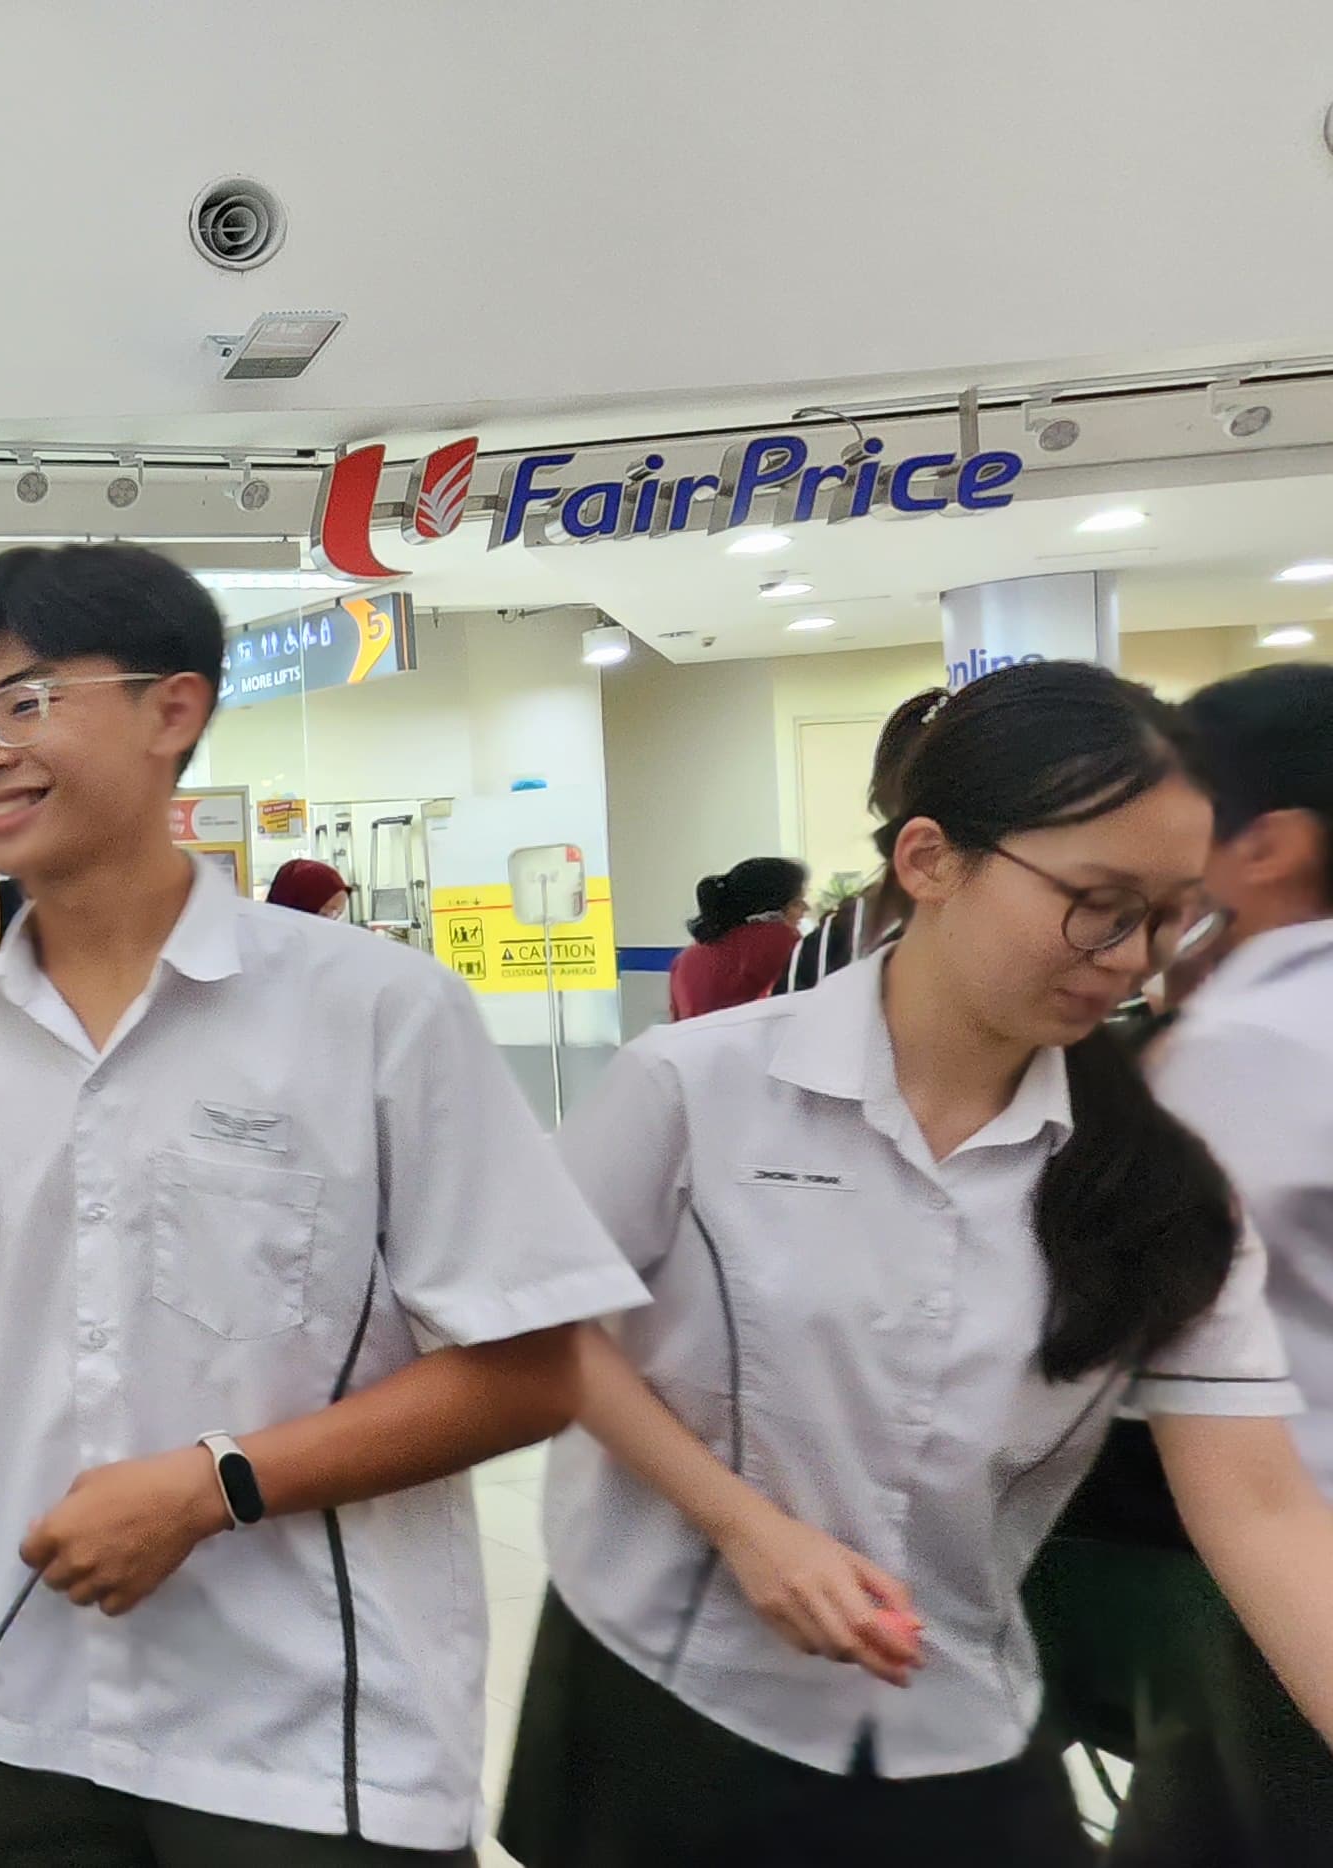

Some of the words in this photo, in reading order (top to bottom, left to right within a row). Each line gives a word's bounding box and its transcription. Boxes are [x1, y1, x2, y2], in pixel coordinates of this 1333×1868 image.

[503, 436, 1023, 544] FairPrice
[242, 674, 272, 693] MORE
[274, 666, 301, 686] LIFTS
[946, 649, 1044, 688] nlin
[519, 944, 596, 960] CAUTION
[560, 965, 596, 976] AHEAD
